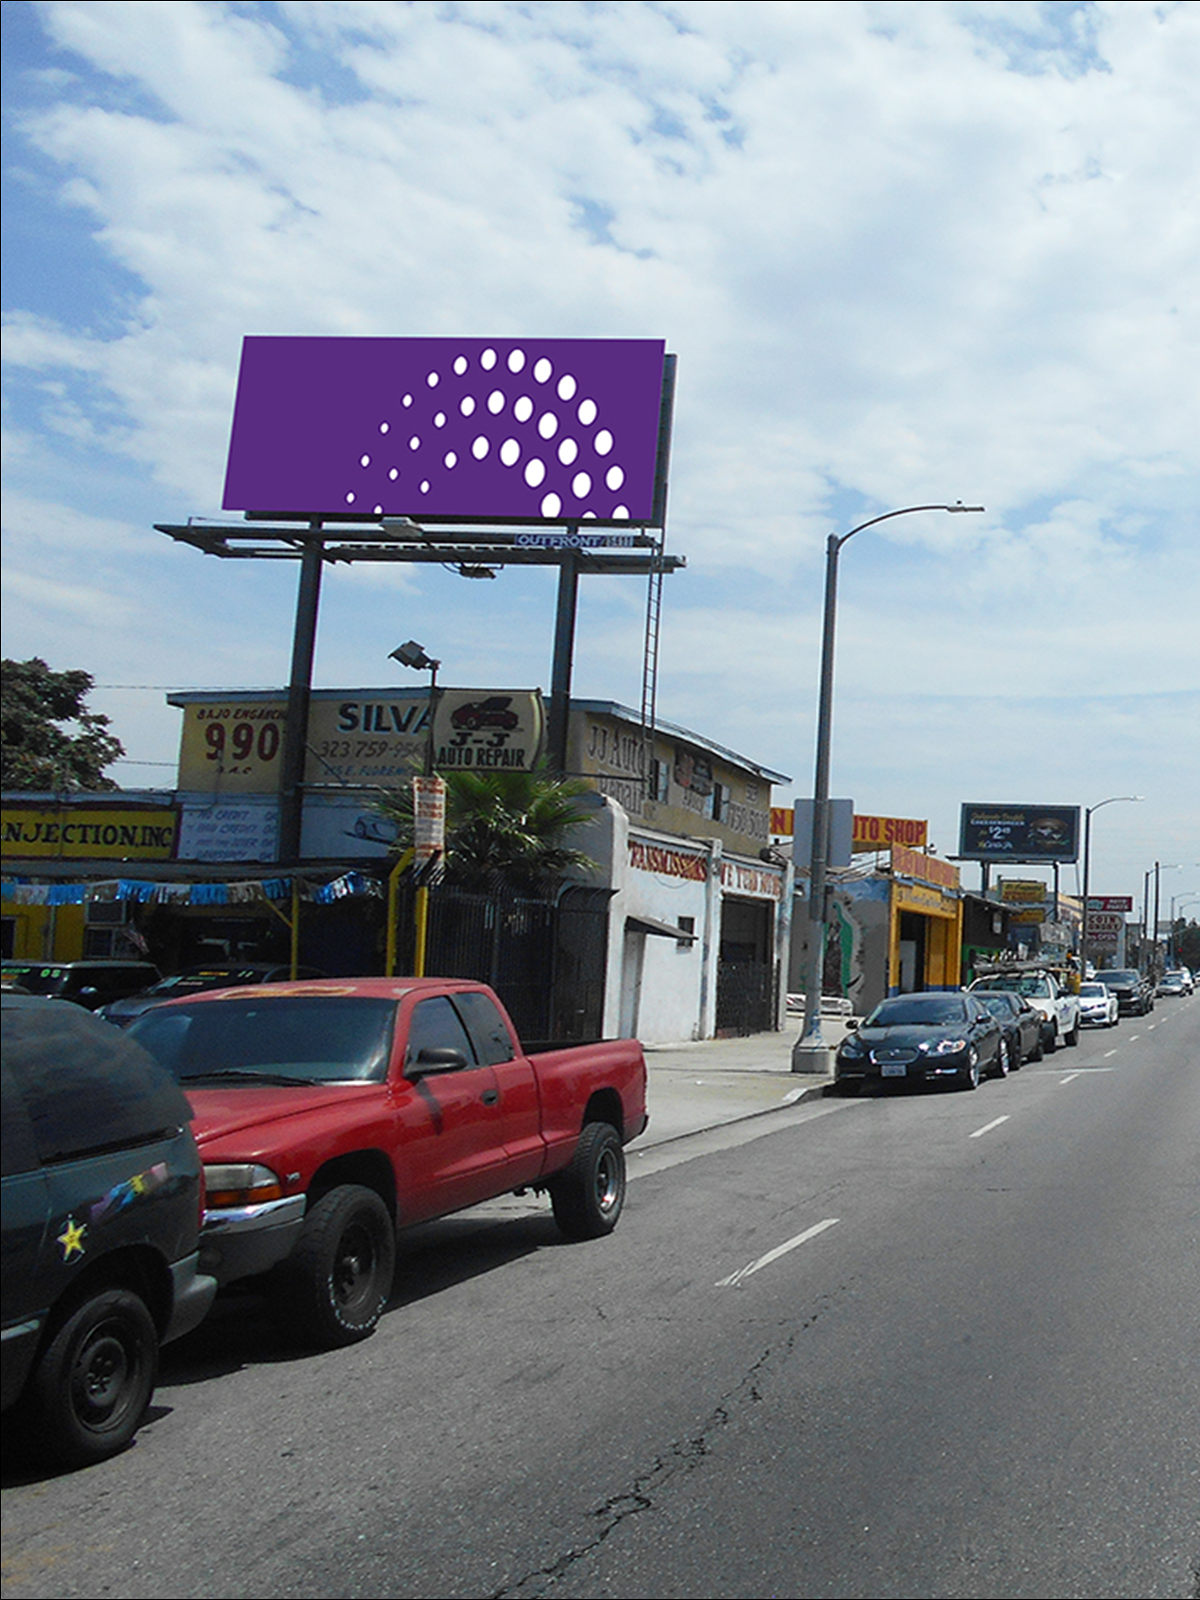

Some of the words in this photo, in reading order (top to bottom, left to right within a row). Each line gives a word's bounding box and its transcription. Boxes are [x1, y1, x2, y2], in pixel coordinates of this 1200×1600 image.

[197, 708, 230, 720] BAJO
[205, 723, 280, 761] 990
[449, 732, 510, 747] J-J
[321, 741, 351, 758] 323
[439, 747, 473, 766] AUTO
[476, 747, 525, 767] REPAIR
[884, 819, 925, 844] SHOP
